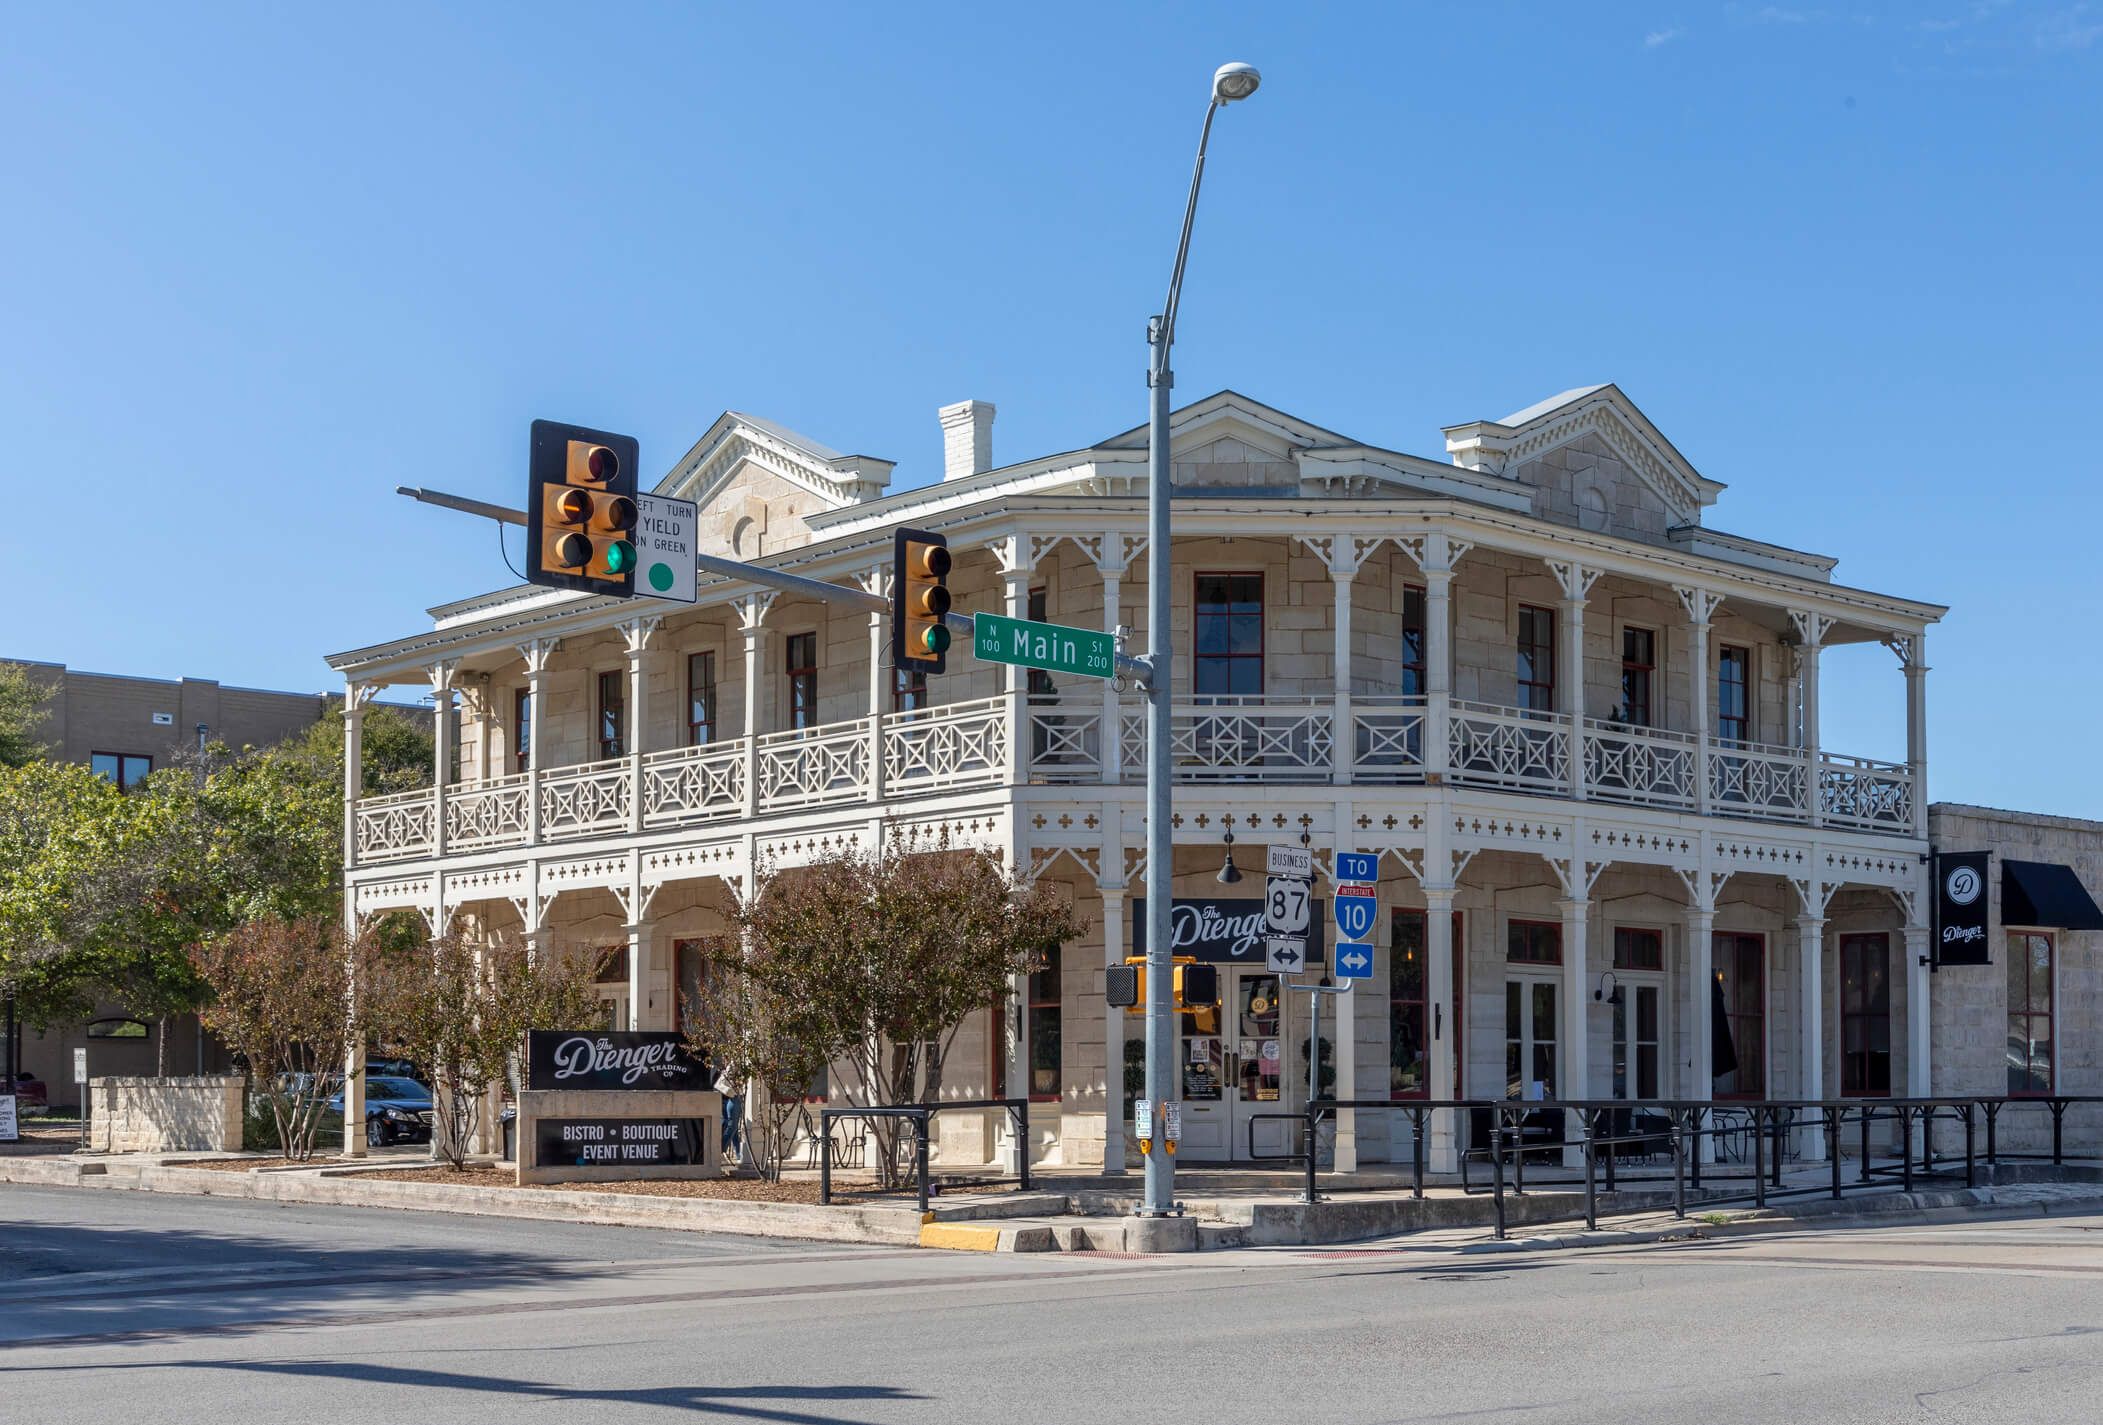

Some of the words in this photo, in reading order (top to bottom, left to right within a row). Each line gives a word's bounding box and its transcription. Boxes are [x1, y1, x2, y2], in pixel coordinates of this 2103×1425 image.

[637, 499, 654, 513] EFT
[666, 504, 692, 519] TURN
[643, 516, 680, 536] YIELD
[654, 538, 686, 554] GREEN
[982, 639, 1000, 653] 100
[989, 624, 997, 637] N
[1013, 628, 1076, 665] Main
[1092, 640, 1103, 654] St
[1087, 655, 1108, 669] 200
[1272, 852, 1309, 869] BUSINESS
[1347, 859, 1368, 876] TO
[1341, 887, 1371, 897] INTERSTATE
[1953, 873, 1974, 895] D
[1202, 905, 1221, 919] The
[1272, 890, 1305, 921] 87
[1344, 904, 1367, 931] 10
[1172, 904, 1266, 956] Dienge
[1943, 926, 1982, 943] Dienger
[596, 1038, 613, 1050] The
[554, 1037, 677, 1085] Dienger
[650, 1064, 688, 1073] TRADING
[563, 1125, 604, 1140] BISTRO
[622, 1125, 679, 1140] BOUTIQUE
[583, 1144, 619, 1159] EVENT
[621, 1144, 659, 1159] VENUE
